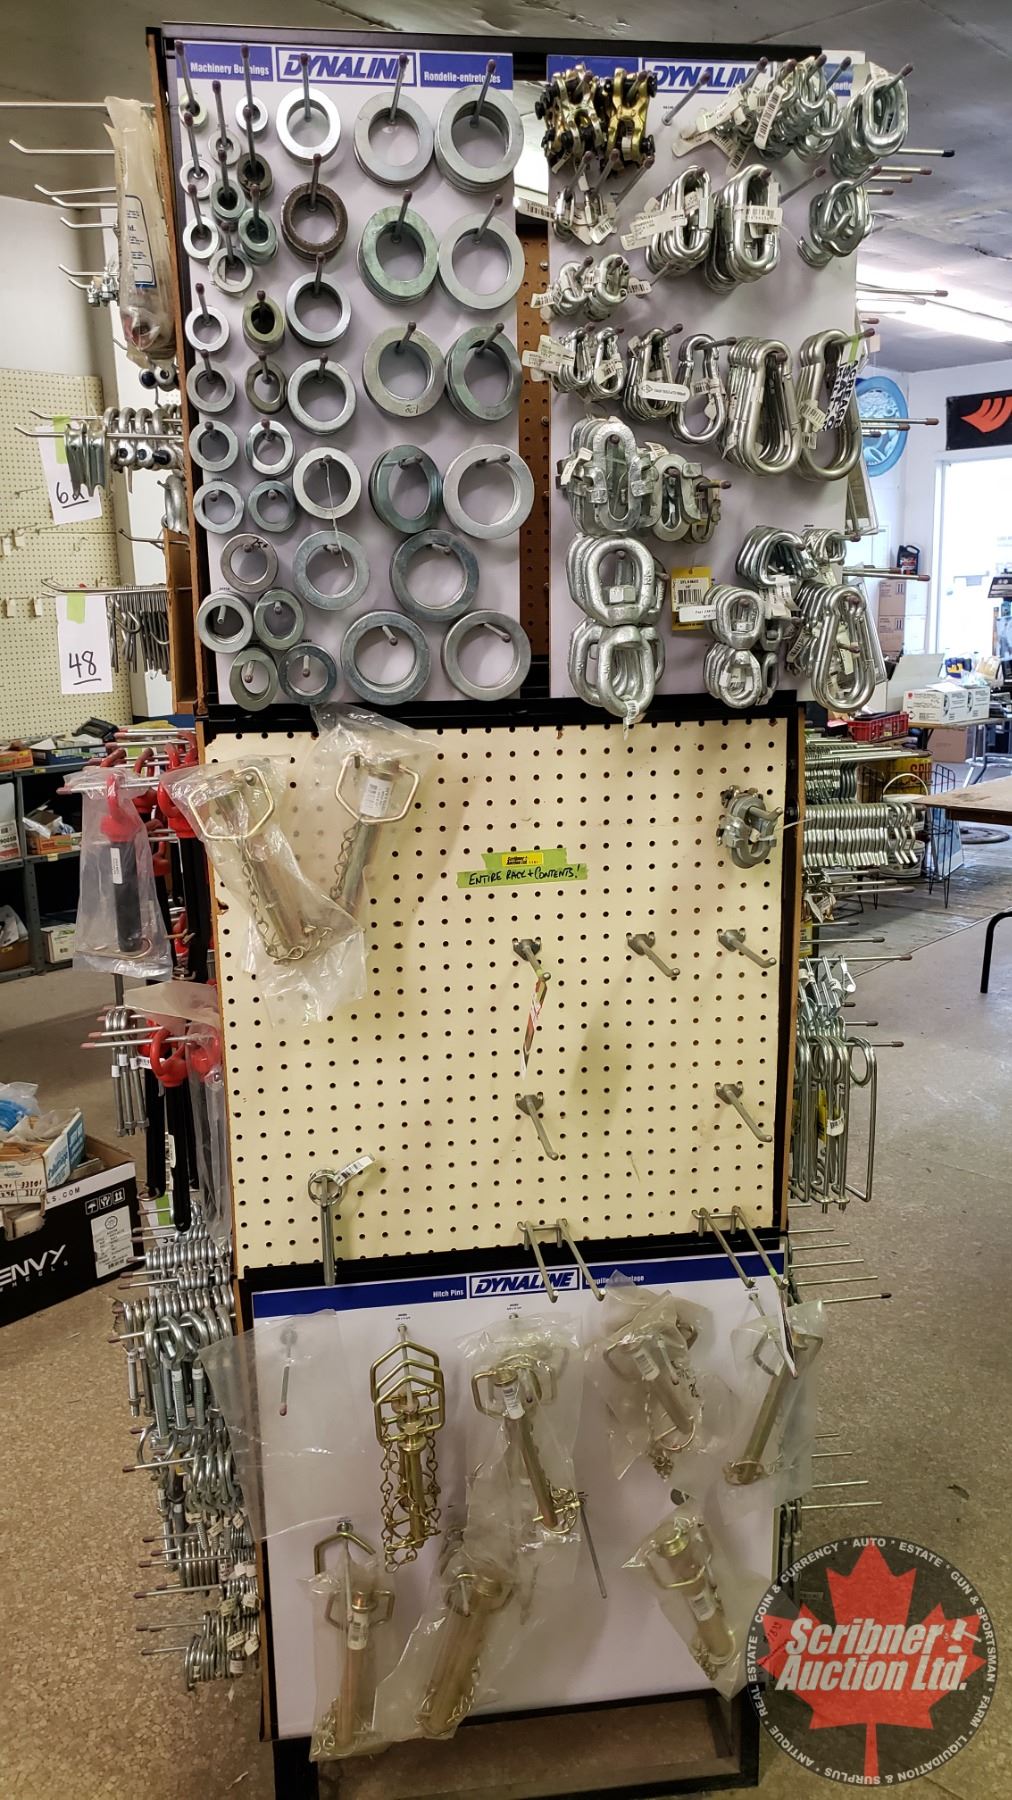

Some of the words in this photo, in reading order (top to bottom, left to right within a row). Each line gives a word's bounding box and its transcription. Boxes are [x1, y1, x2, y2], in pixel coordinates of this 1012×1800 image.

[190, 62, 232, 75] Machinery
[69, 650, 97, 678] 48
[469, 871, 502, 885] ENTIRE
[432, 1290, 449, 1299] Hitch
[450, 1288, 465, 1297] Pins
